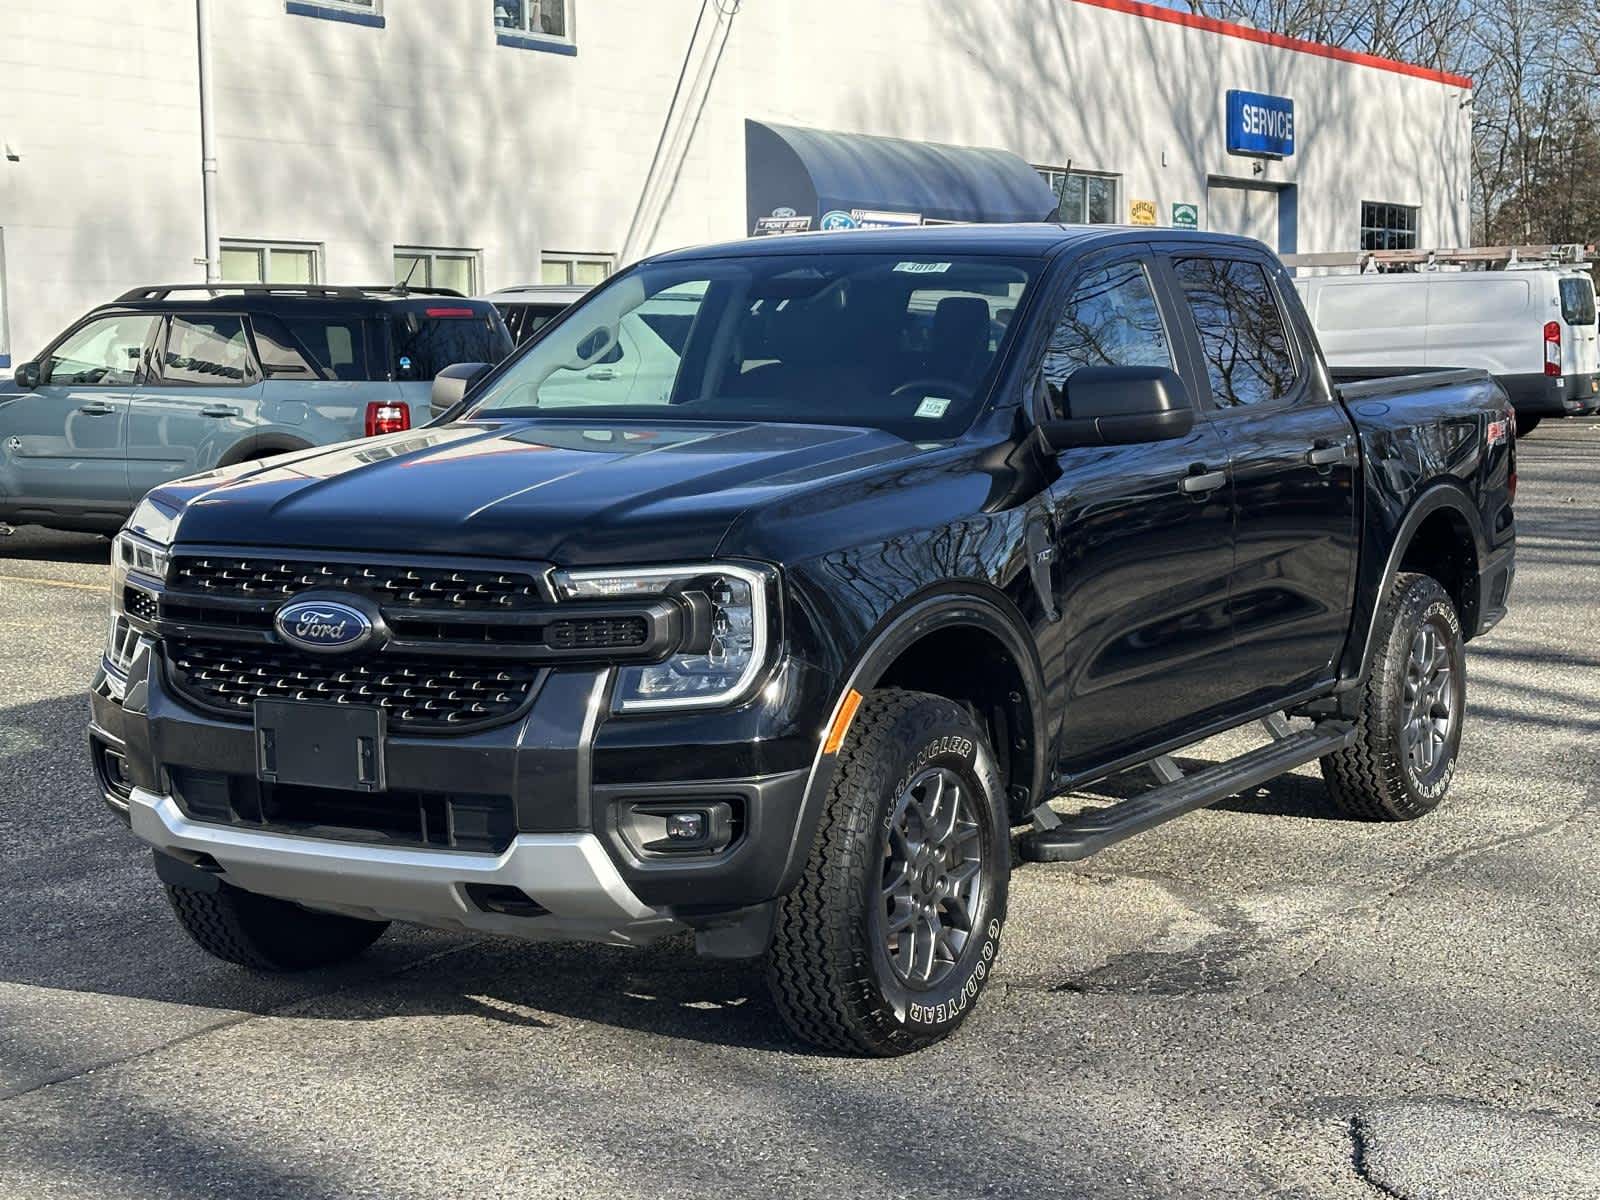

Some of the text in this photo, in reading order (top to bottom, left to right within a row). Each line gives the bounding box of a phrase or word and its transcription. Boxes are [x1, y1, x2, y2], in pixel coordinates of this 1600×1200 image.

[1242, 103, 1293, 140] SERVICE
[295, 610, 346, 639] Ford
[909, 917, 1001, 1026] GOODYEAR
